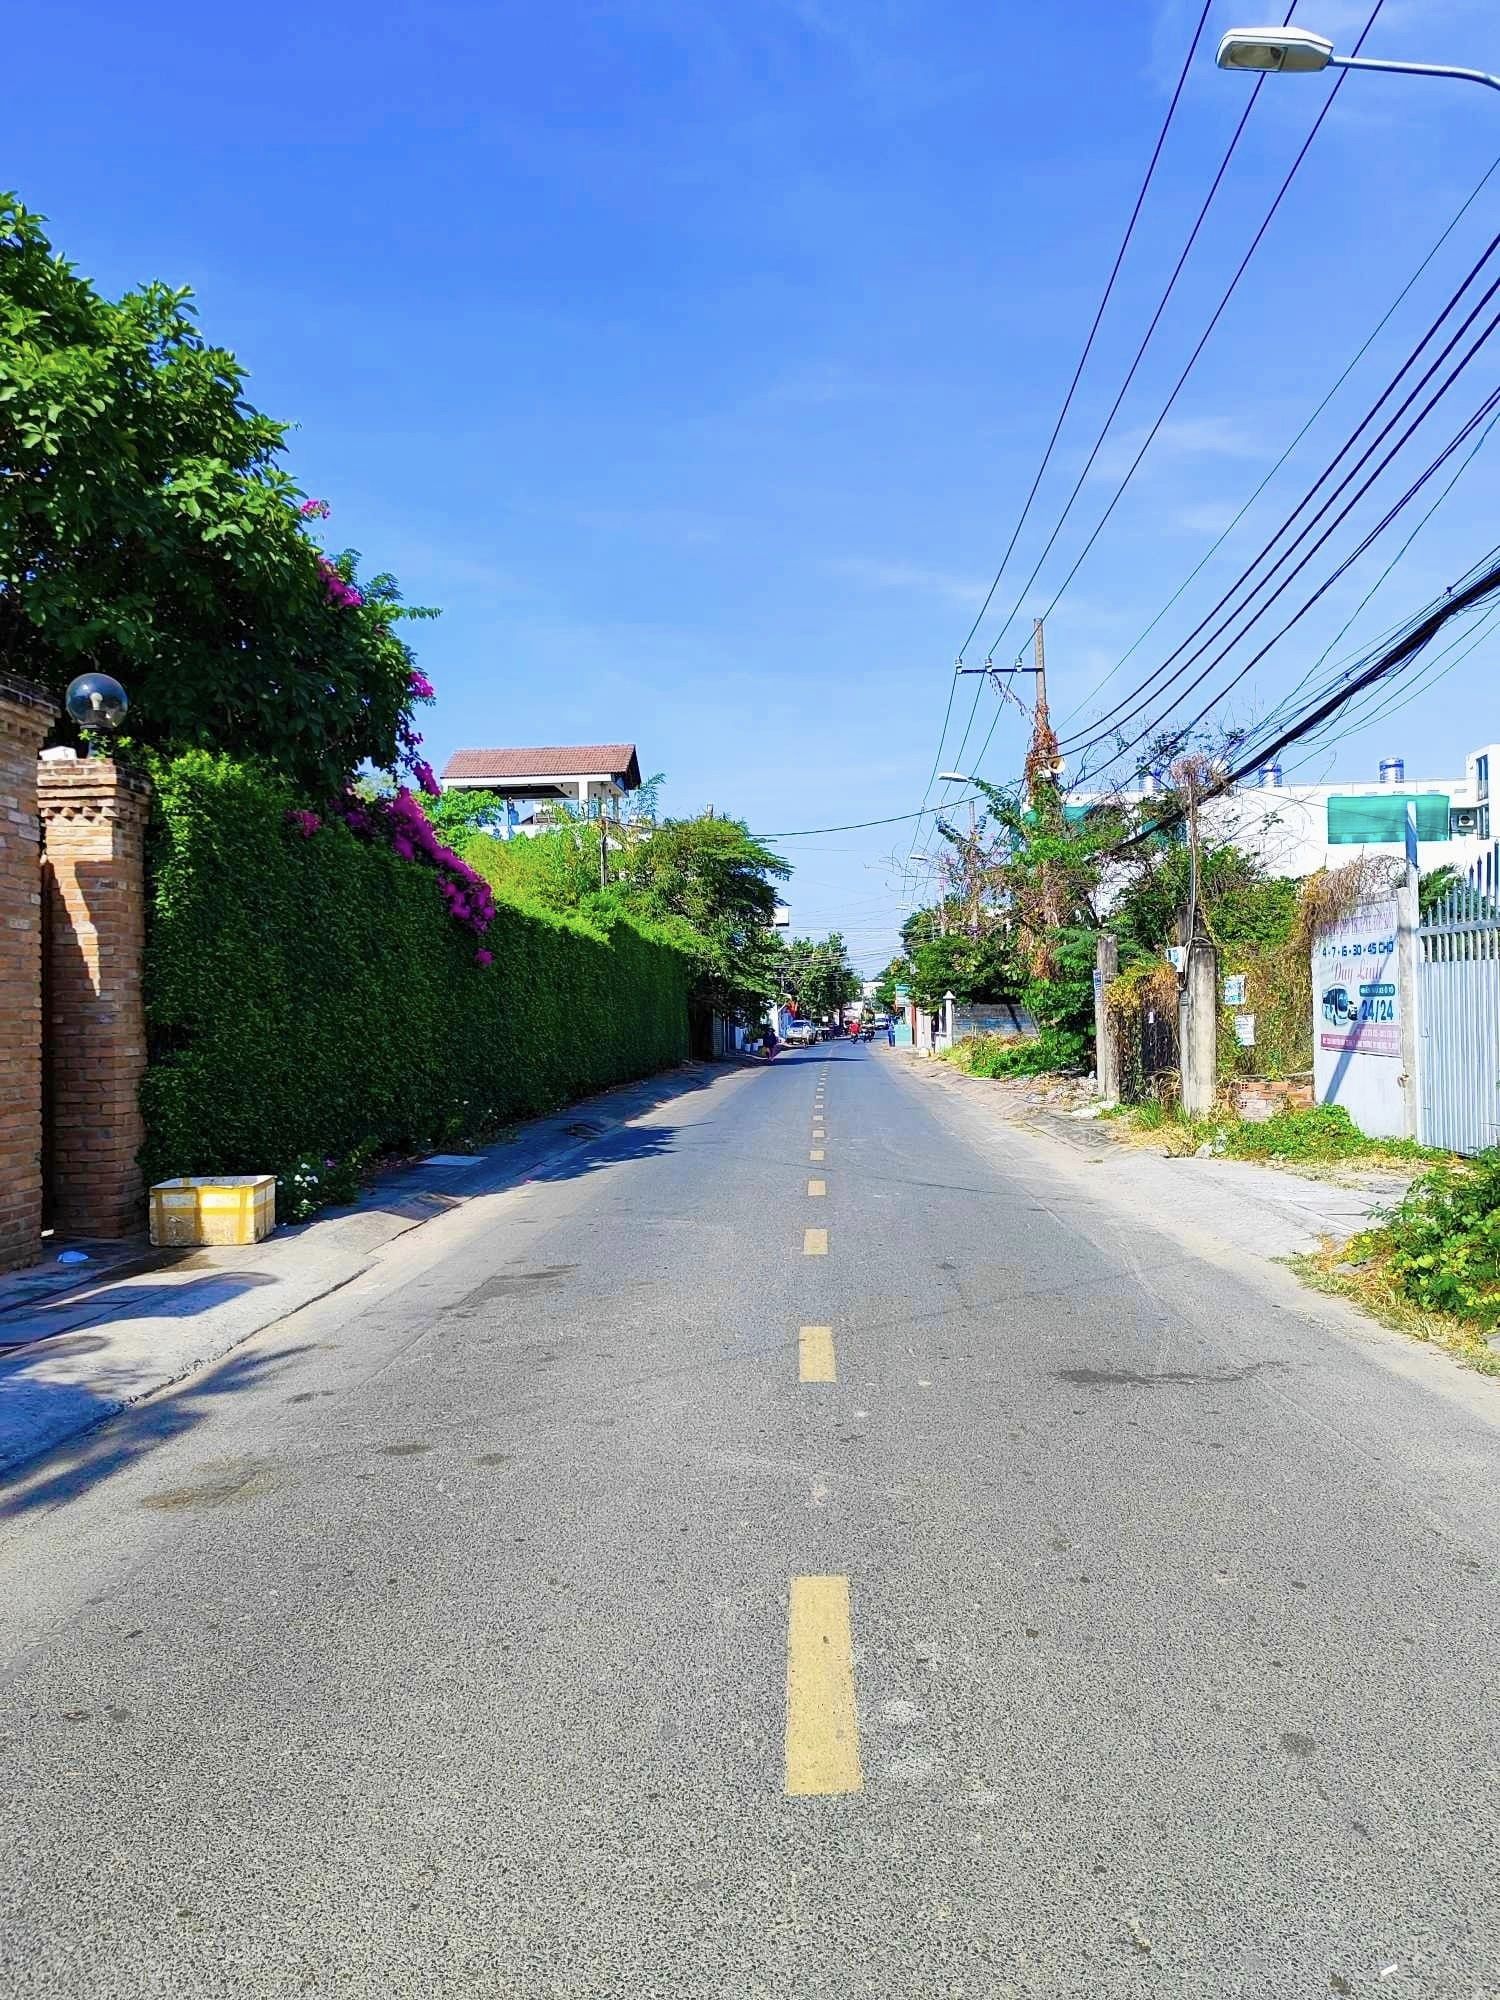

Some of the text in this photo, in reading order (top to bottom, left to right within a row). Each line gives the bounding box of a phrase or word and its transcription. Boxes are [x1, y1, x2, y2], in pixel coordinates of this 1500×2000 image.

[1353, 944, 1361, 956] 30
[1368, 943, 1376, 955] 45
[1361, 999, 1394, 1022] 24/24
